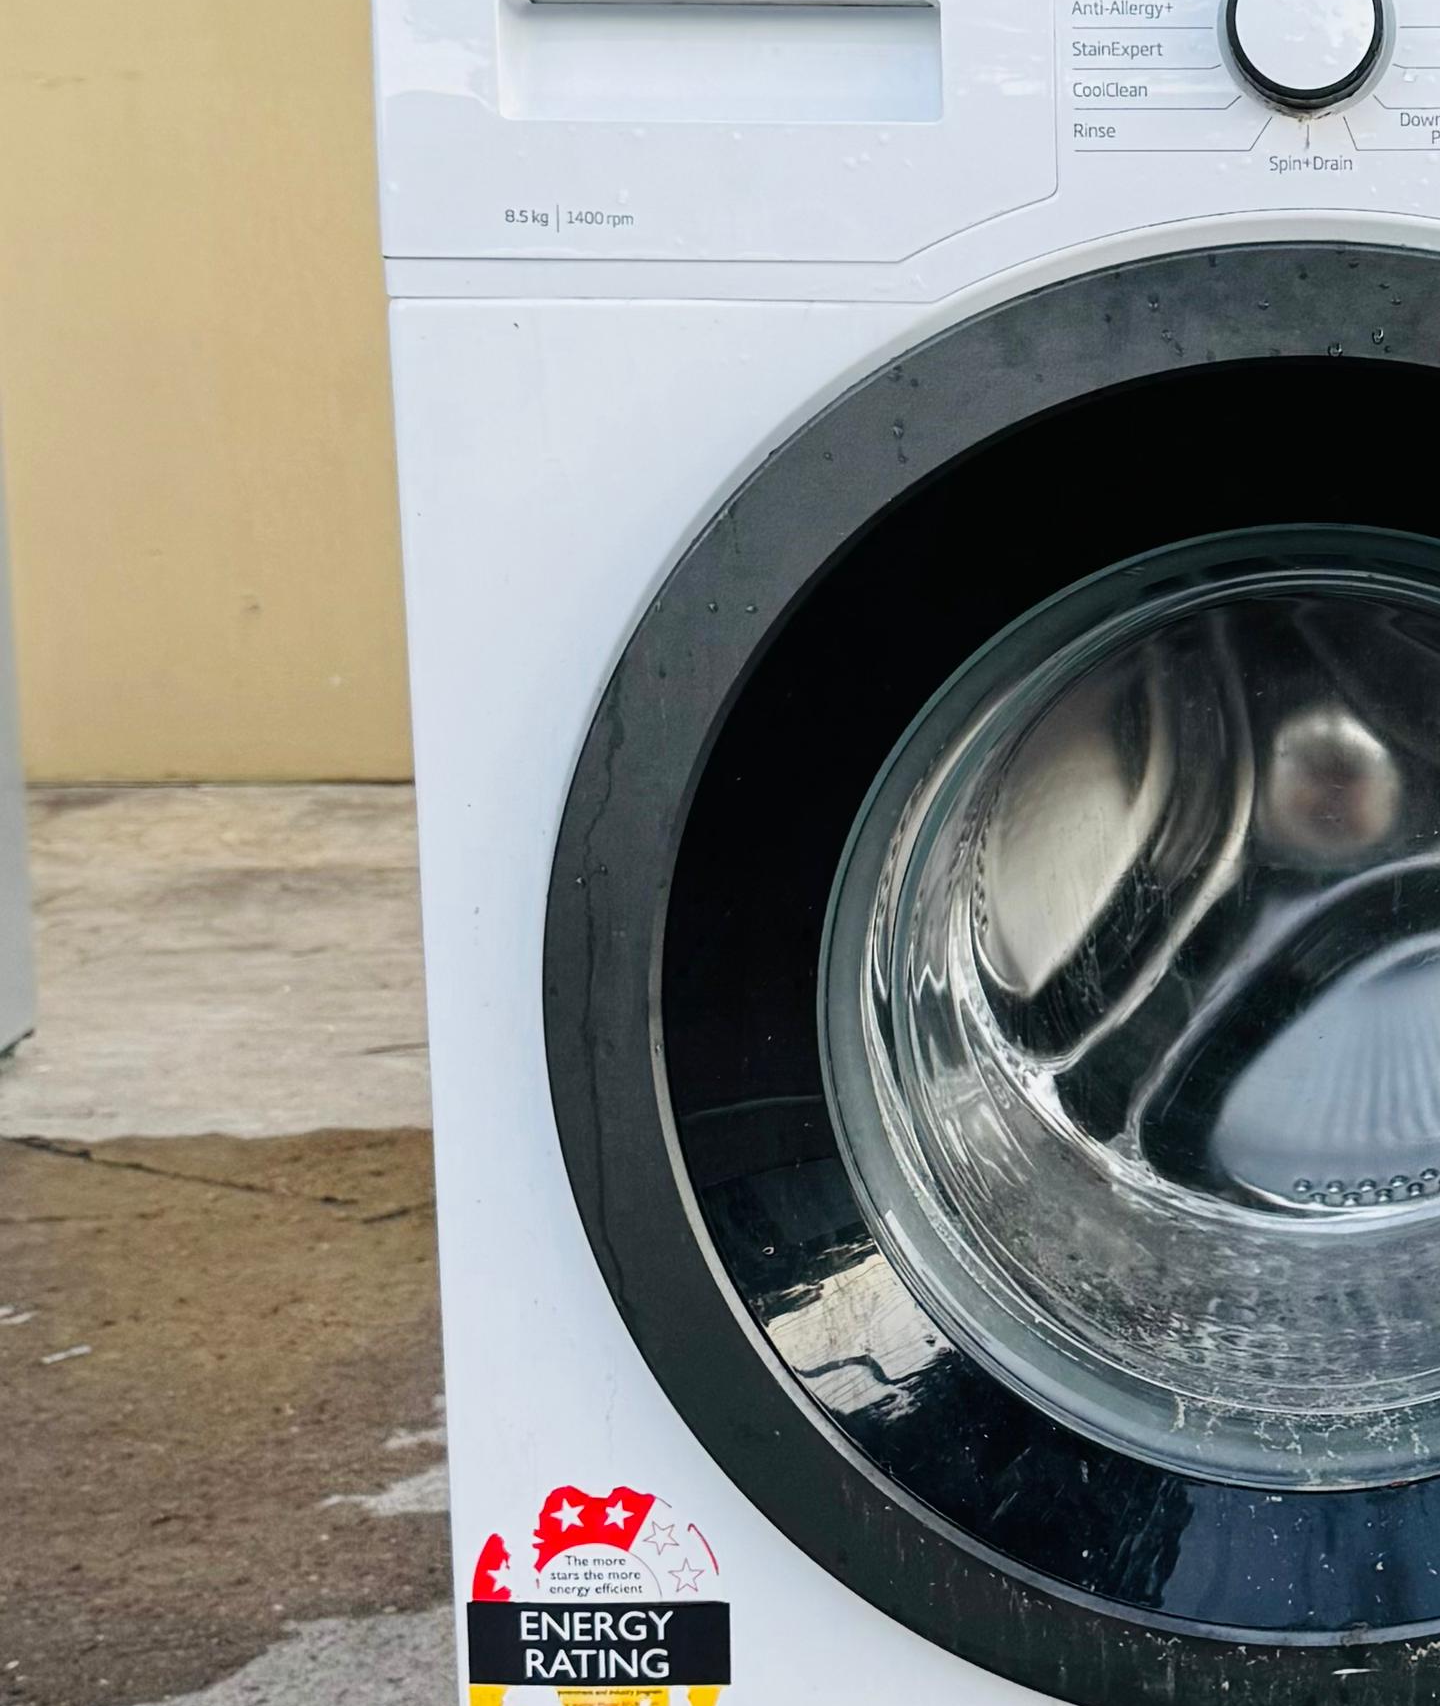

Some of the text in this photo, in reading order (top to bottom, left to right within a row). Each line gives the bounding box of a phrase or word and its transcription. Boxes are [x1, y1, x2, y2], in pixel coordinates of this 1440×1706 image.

[1071, 0, 1174, 19] Anti-Allergy+
[1071, 41, 1163, 60] StainExpert
[1072, 82, 1148, 99] CoolClean
[1072, 123, 1117, 140] Rinse
[1268, 155, 1354, 173] Spin+Drain
[504, 208, 550, 227] 8.5 kg
[566, 210, 635, 229] 1400 rpm
[564, 1554, 627, 1567] The more
[549, 1569, 641, 1581] stars the more
[549, 1584, 643, 1597] energy efficient
[519, 1609, 674, 1642] ENERGY
[524, 1648, 670, 1679] RATING
